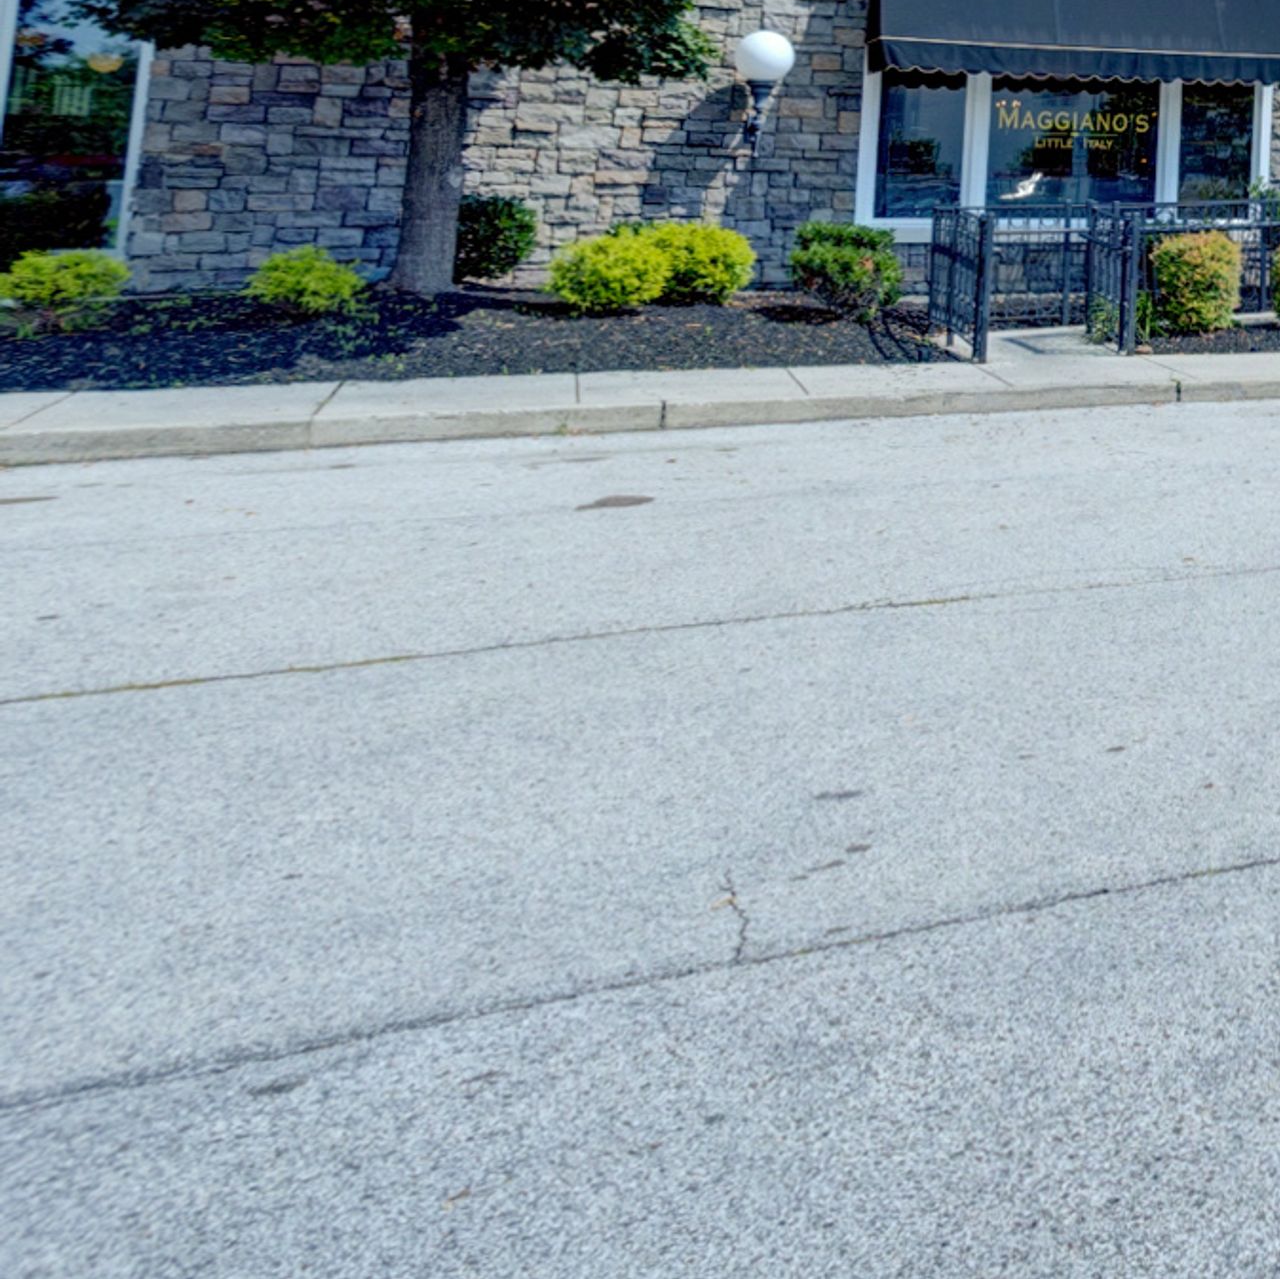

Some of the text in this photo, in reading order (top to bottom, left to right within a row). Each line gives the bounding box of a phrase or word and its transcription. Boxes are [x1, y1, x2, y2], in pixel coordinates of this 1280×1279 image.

[999, 107, 1149, 133] MAGGIANO'S
[1034, 136, 1113, 150] LITTLE ITALY
